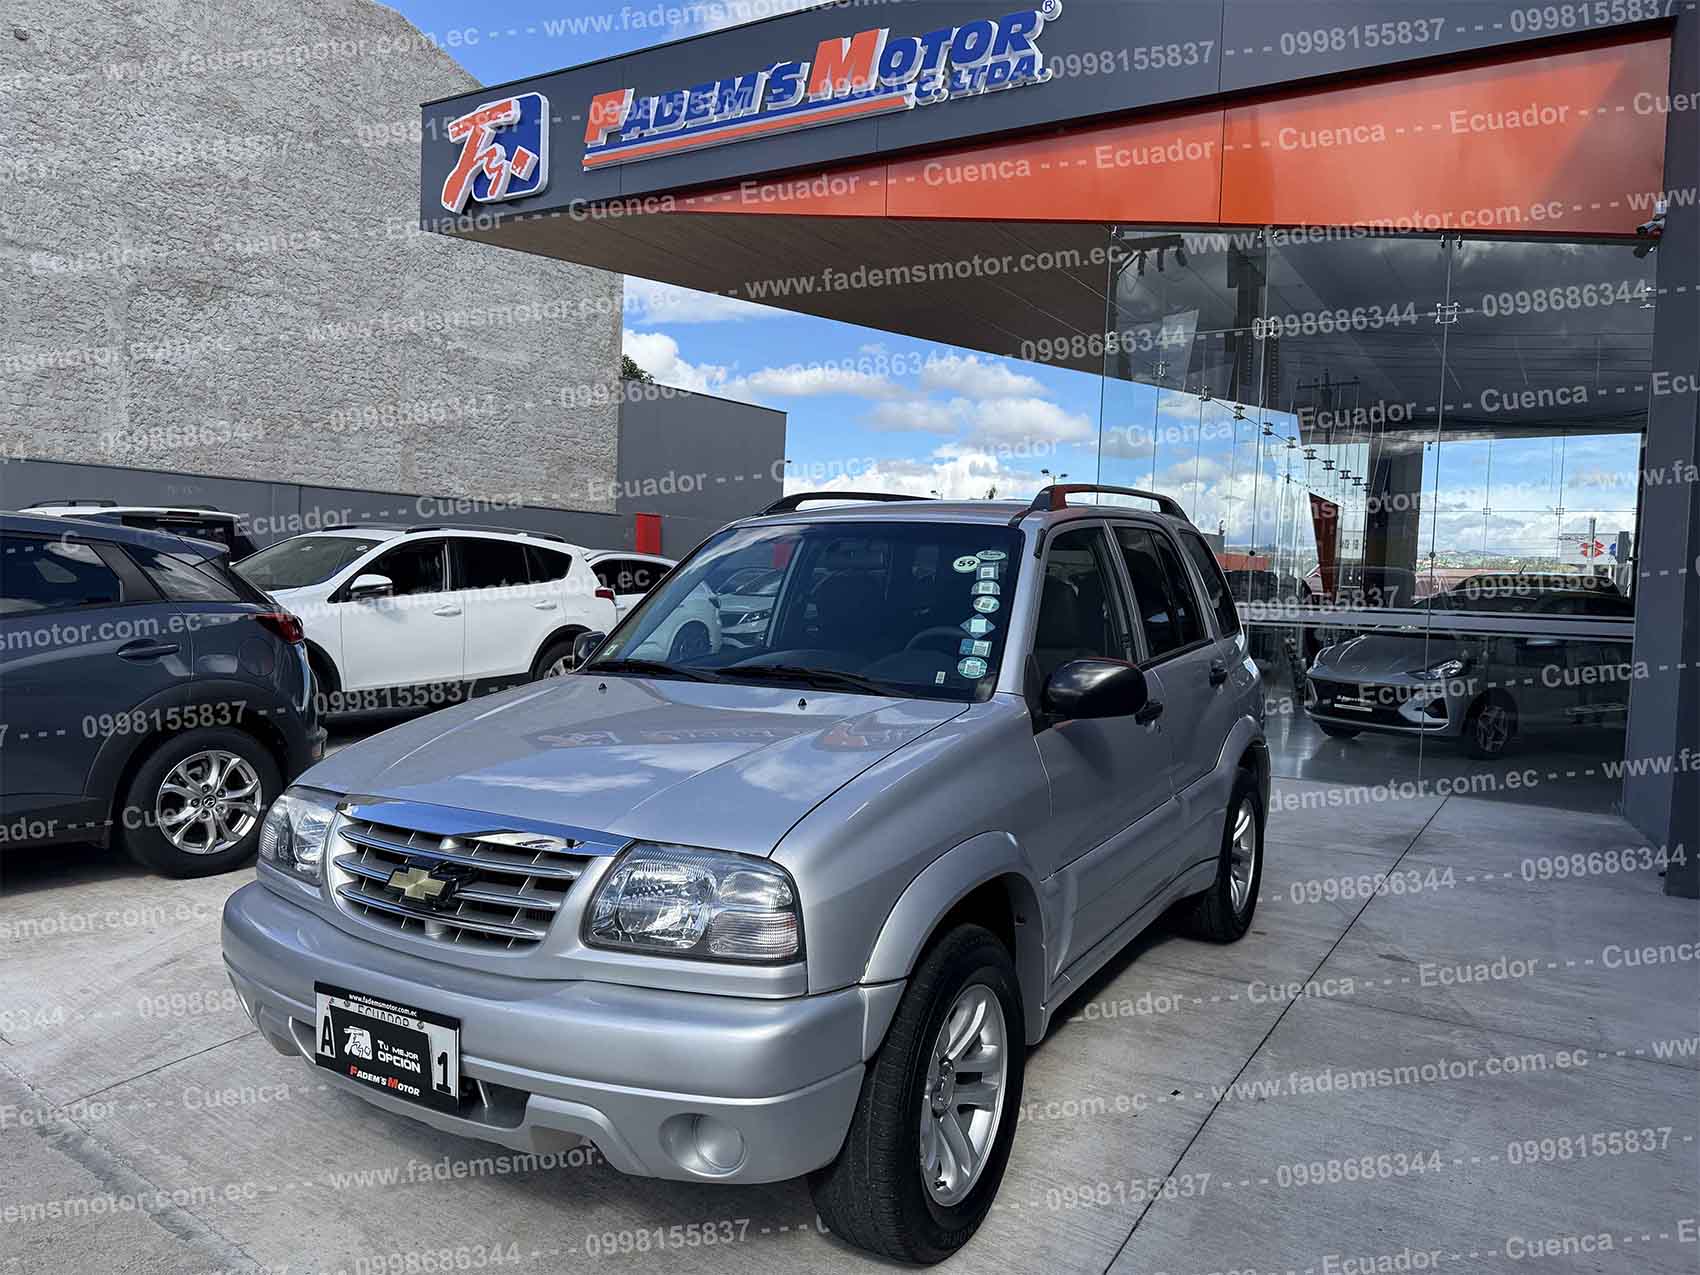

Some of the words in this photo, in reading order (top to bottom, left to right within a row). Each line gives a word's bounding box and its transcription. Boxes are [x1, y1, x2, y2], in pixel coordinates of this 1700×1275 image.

[808, 10, 1044, 96] MOTOR
[320, 1015, 334, 1056] A
[377, 1052, 421, 1074] OPCION
[391, 1046, 419, 1061] MEJOR
[387, 1076, 420, 1097] MOTOR
[436, 1051, 452, 1094] 1
